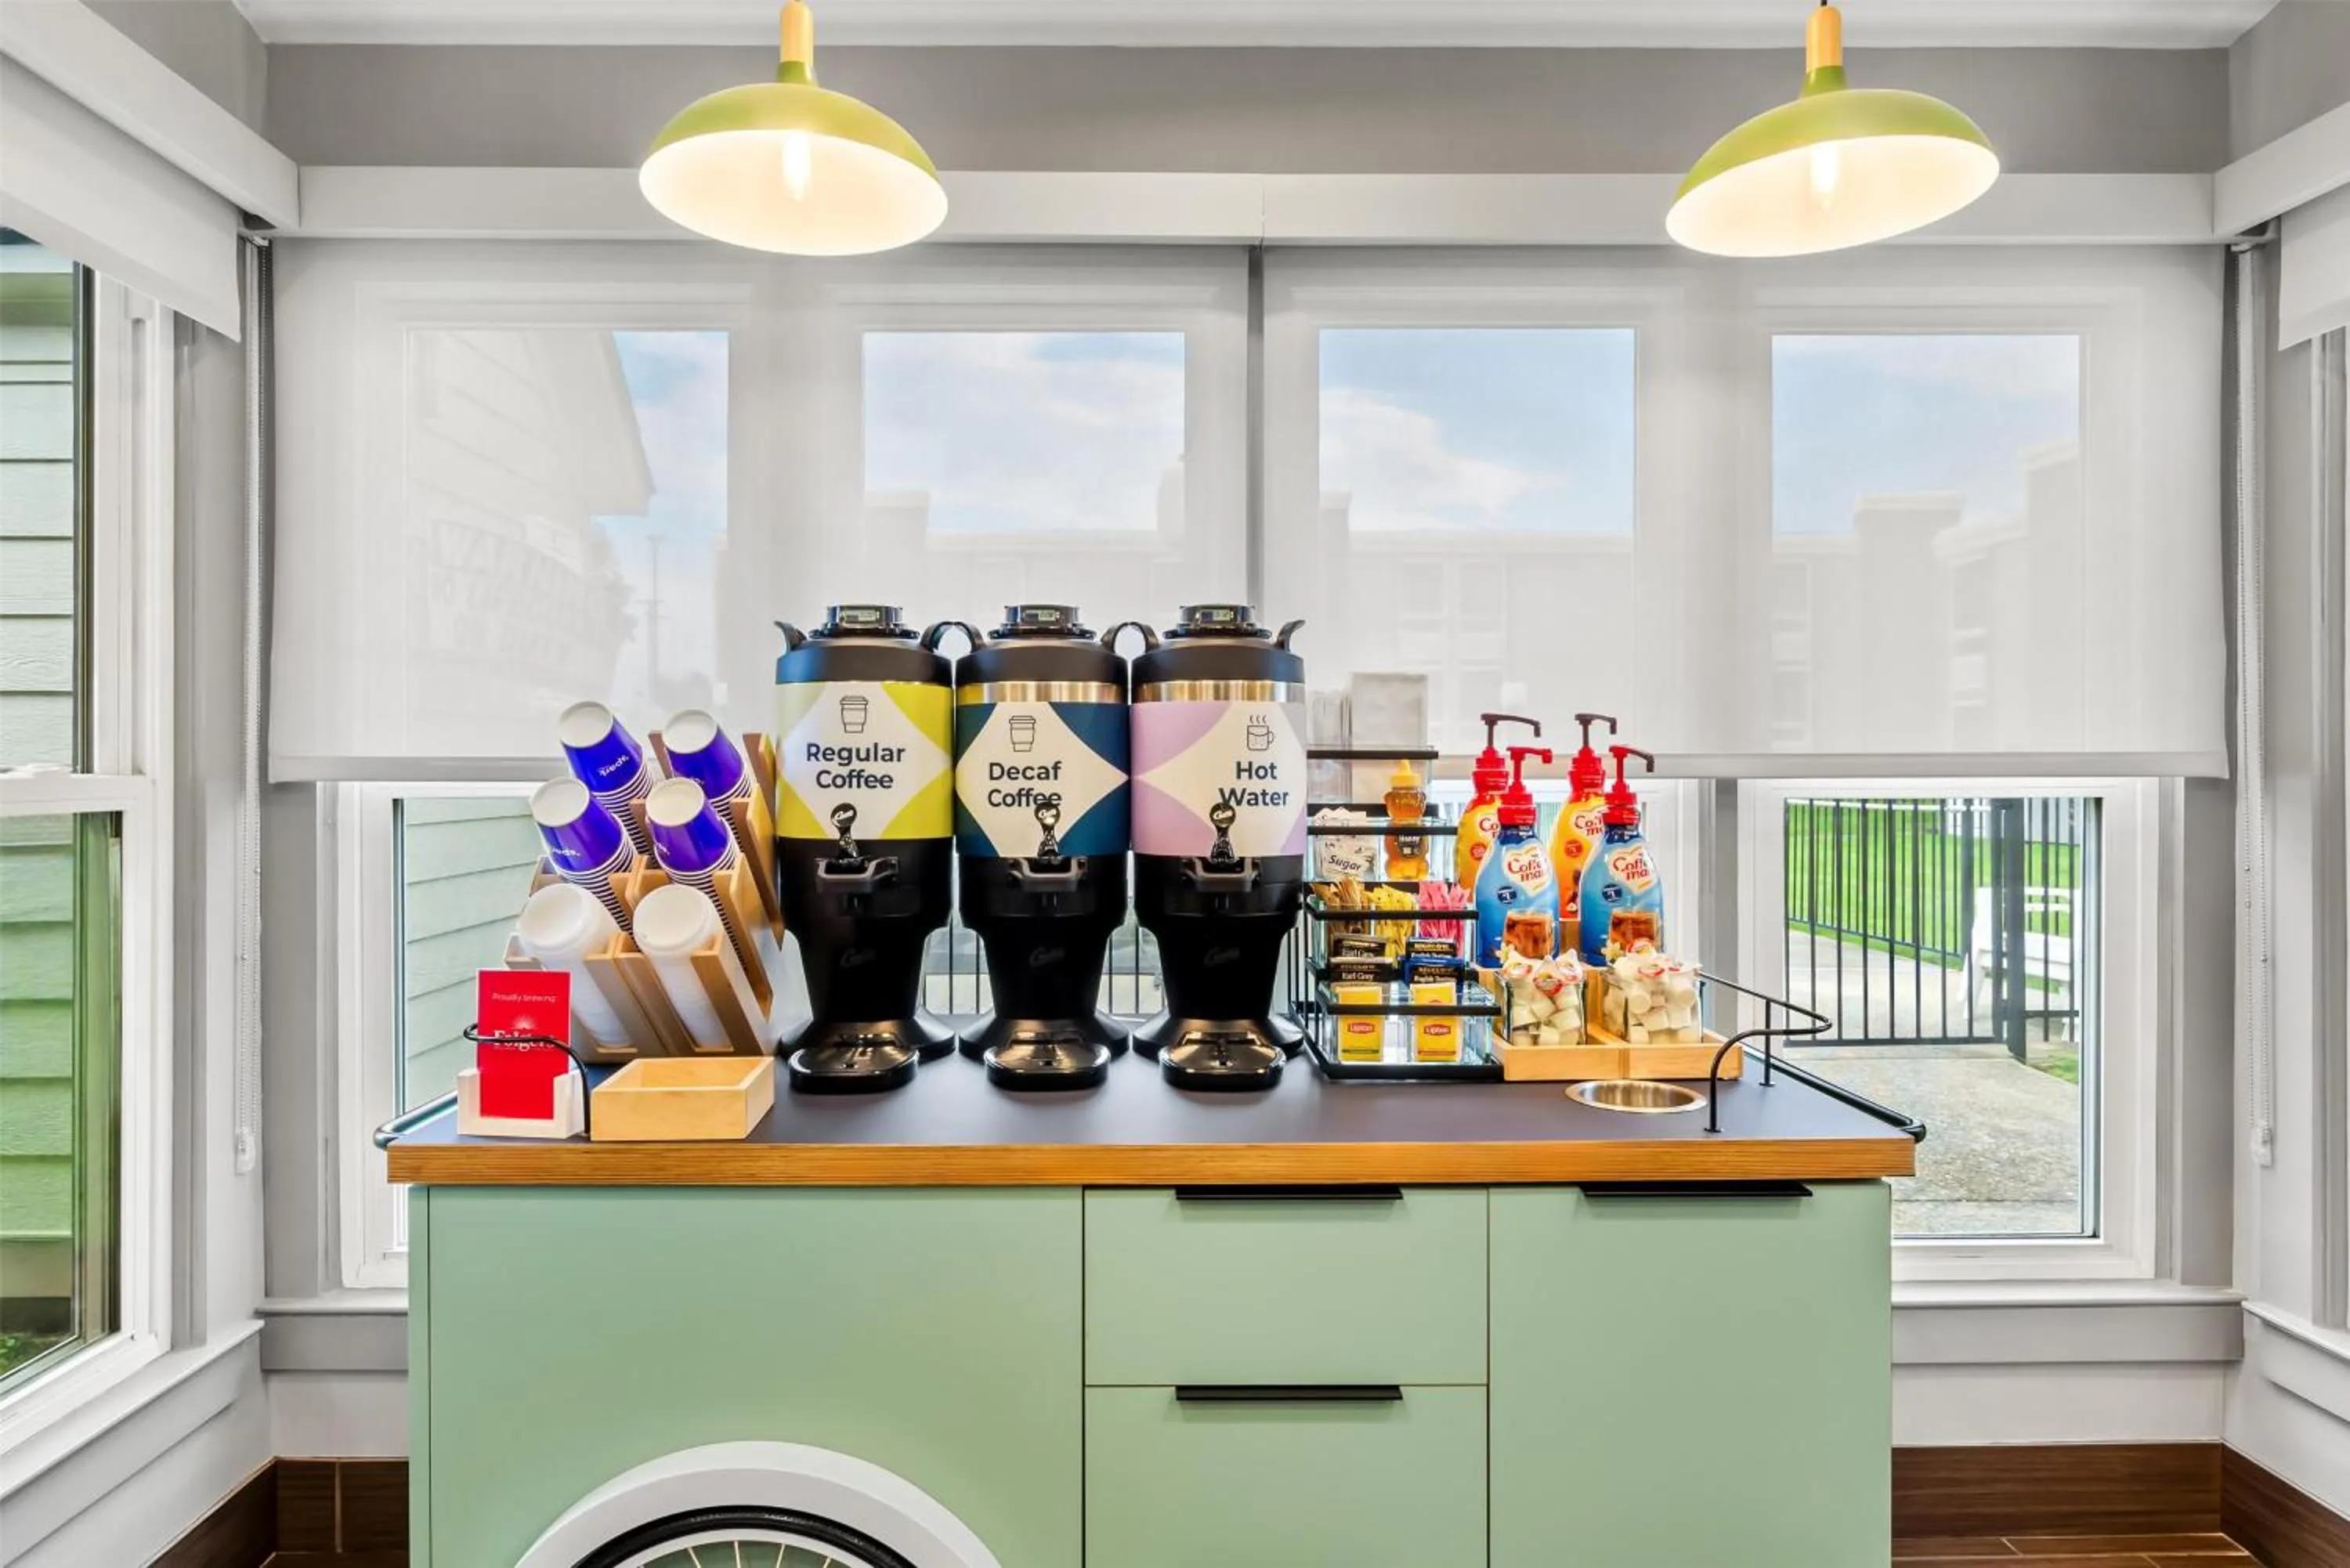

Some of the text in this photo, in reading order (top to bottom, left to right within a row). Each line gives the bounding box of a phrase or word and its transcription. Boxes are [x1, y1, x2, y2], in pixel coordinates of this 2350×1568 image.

[806, 742, 906, 767] Regular
[816, 768, 894, 789] Coffee
[989, 761, 1062, 781] Decaf
[1236, 761, 1278, 780] Hot
[988, 787, 1062, 807] Coffee
[1218, 787, 1289, 807] Water
[1329, 854, 1362, 872] Sugar
